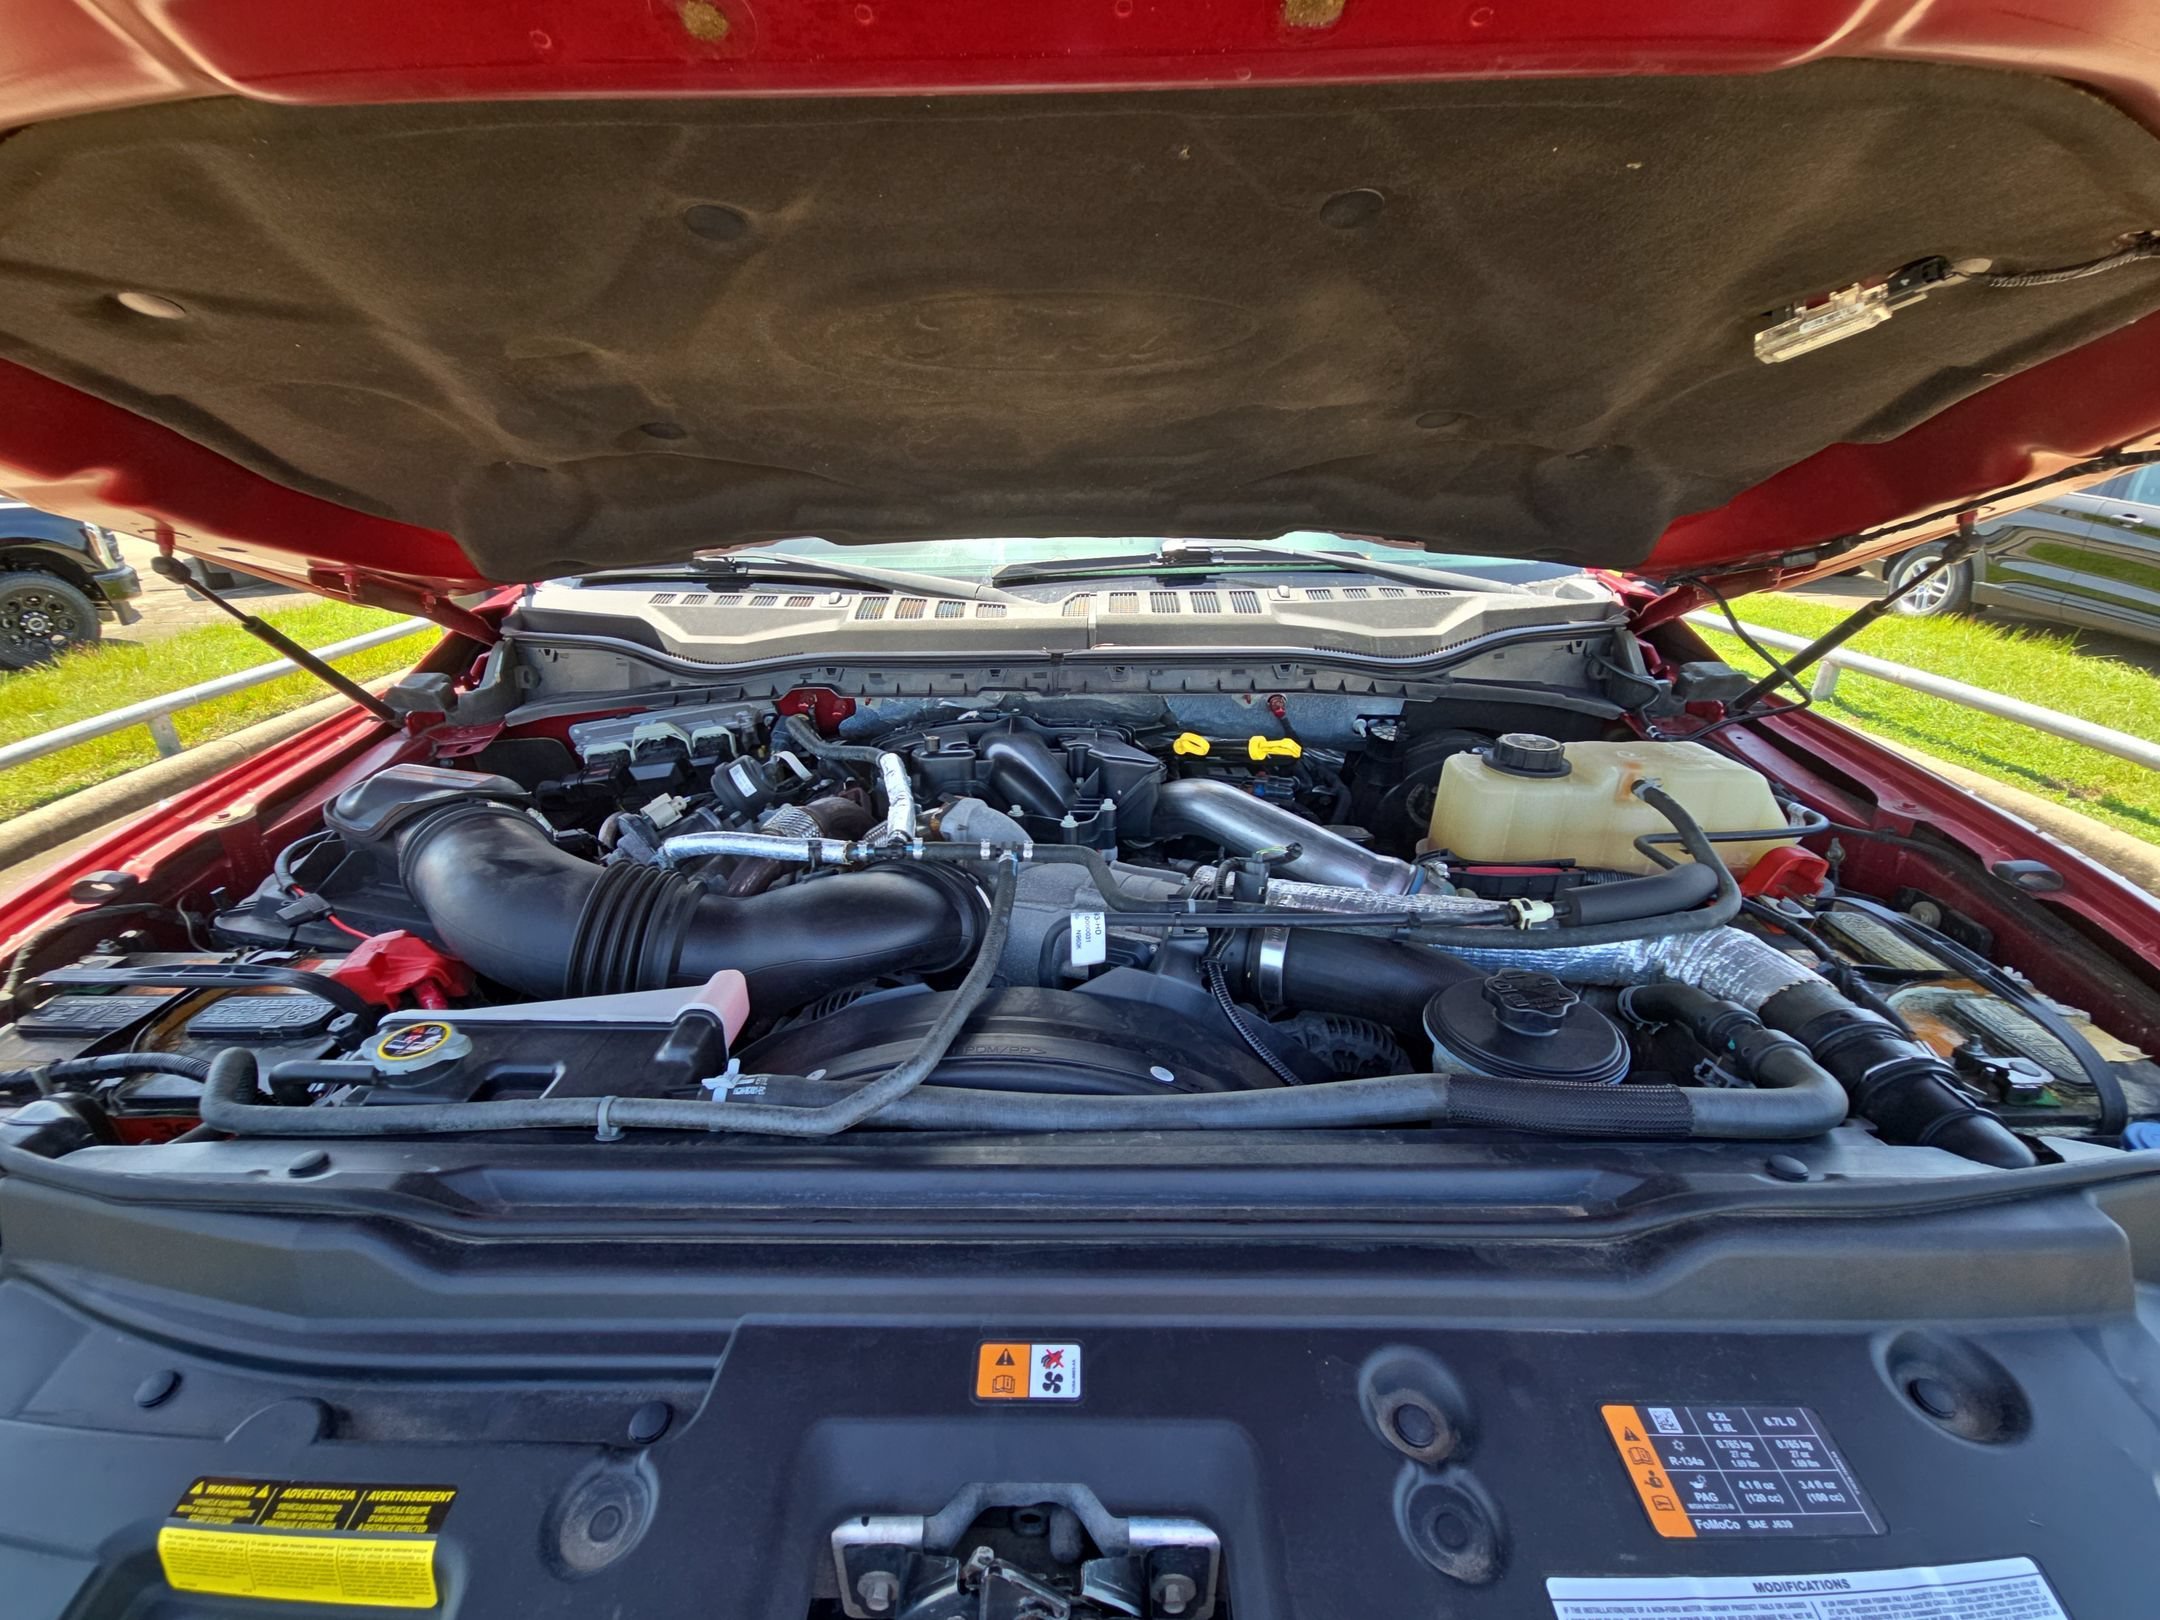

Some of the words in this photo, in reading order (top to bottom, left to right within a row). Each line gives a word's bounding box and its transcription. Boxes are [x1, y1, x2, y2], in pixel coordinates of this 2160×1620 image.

[1763, 1417, 1788, 1427] 6.7L
[1786, 1417, 1798, 1427] D
[1668, 1456, 1706, 1466] R-134a
[1738, 1481, 1754, 1490] 4.1
[1798, 1480, 1815, 1490] 3.4
[205, 1485, 257, 1498] WARNING
[279, 1488, 357, 1502] ADVERTENCIA
[366, 1489, 457, 1503] AVERTISSEMENT
[1694, 1492, 1719, 1502] PAG
[1694, 1519, 1742, 1530] FoMoCo
[1747, 1519, 1769, 1529] SAE
[1752, 1578, 1851, 1593] MODIFICATIONS
